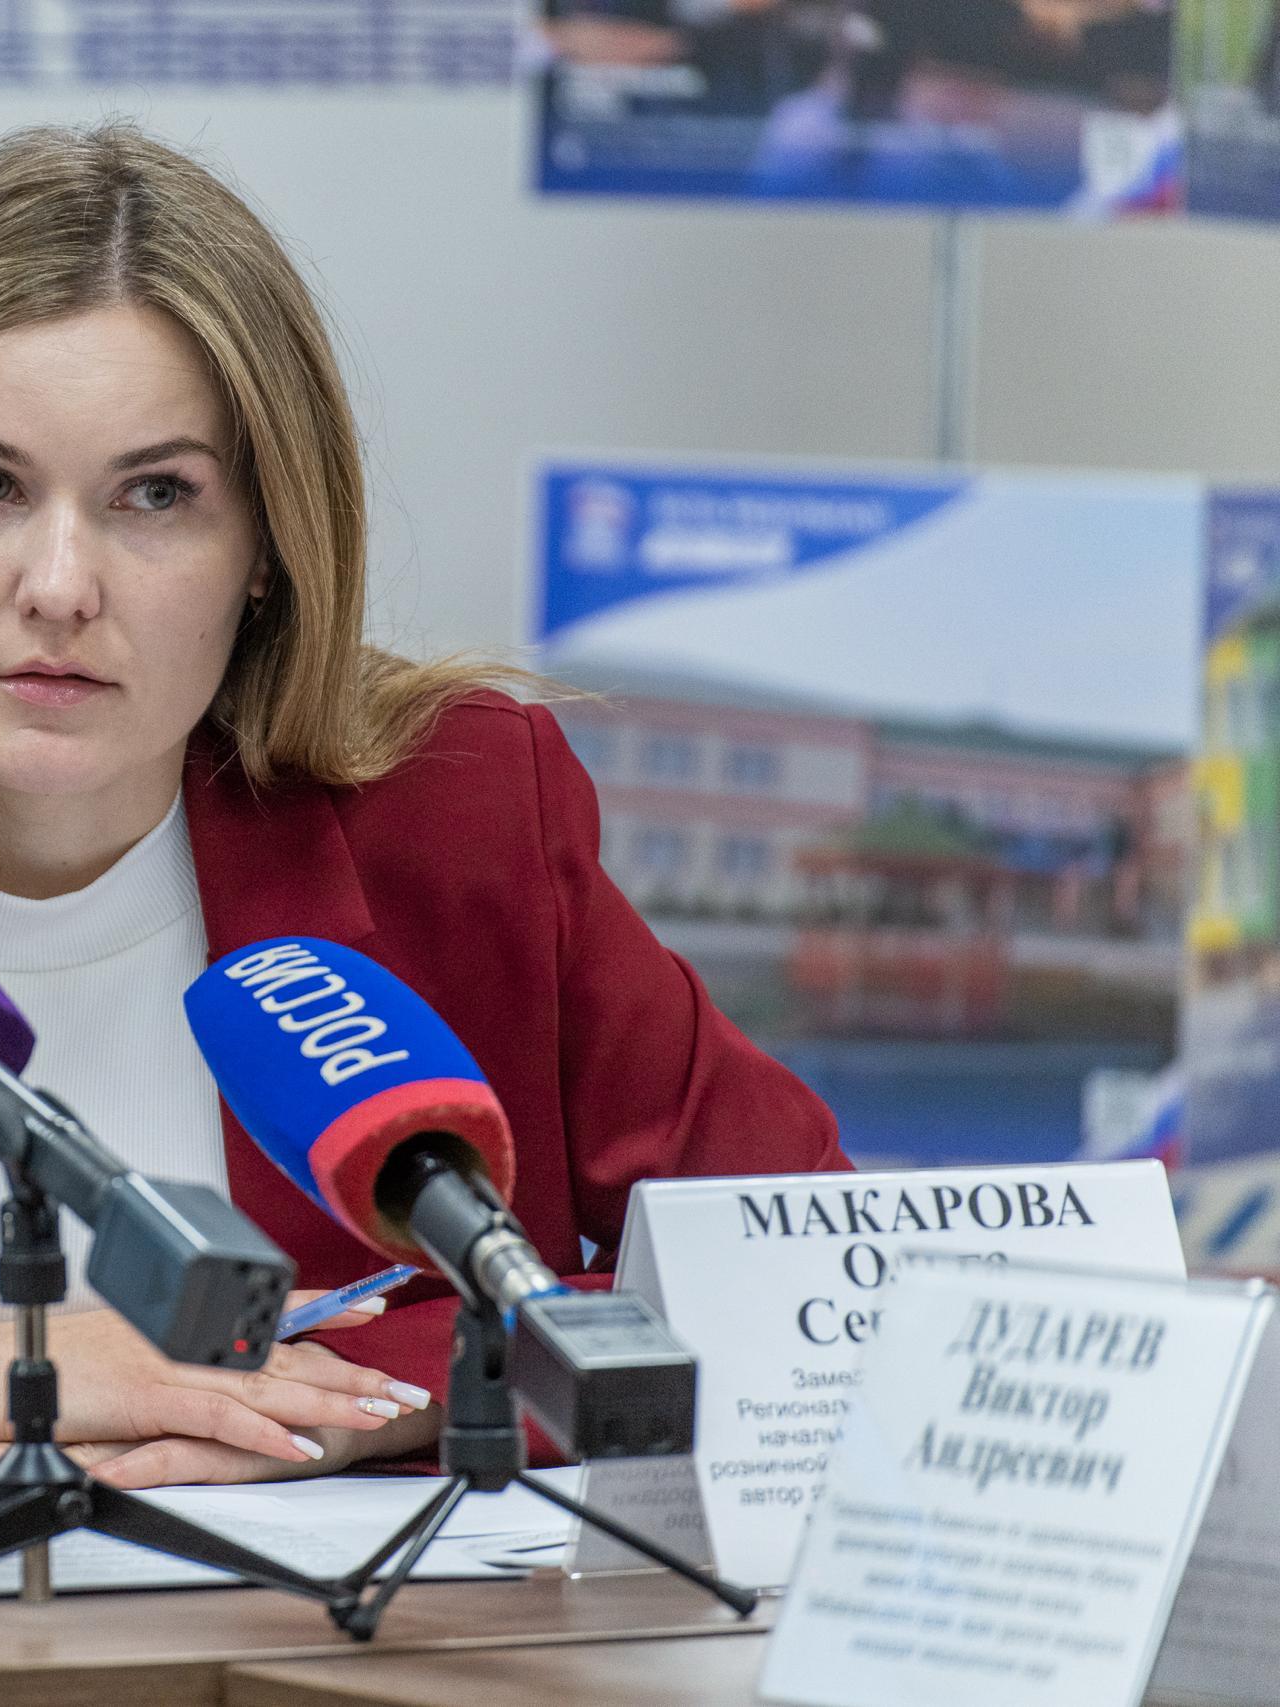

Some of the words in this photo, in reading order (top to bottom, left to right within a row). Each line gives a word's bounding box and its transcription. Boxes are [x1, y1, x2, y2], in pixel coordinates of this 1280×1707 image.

[224, 943, 410, 1087] РОССИЯ
[737, 1181, 1096, 1239] МАКАРОВА
[943, 1298, 1168, 1374] ДУДАРЕВ
[960, 1362, 1111, 1442] Виктор
[901, 1418, 1125, 1495] Андреевич
[739, 1485, 804, 1508] автор
